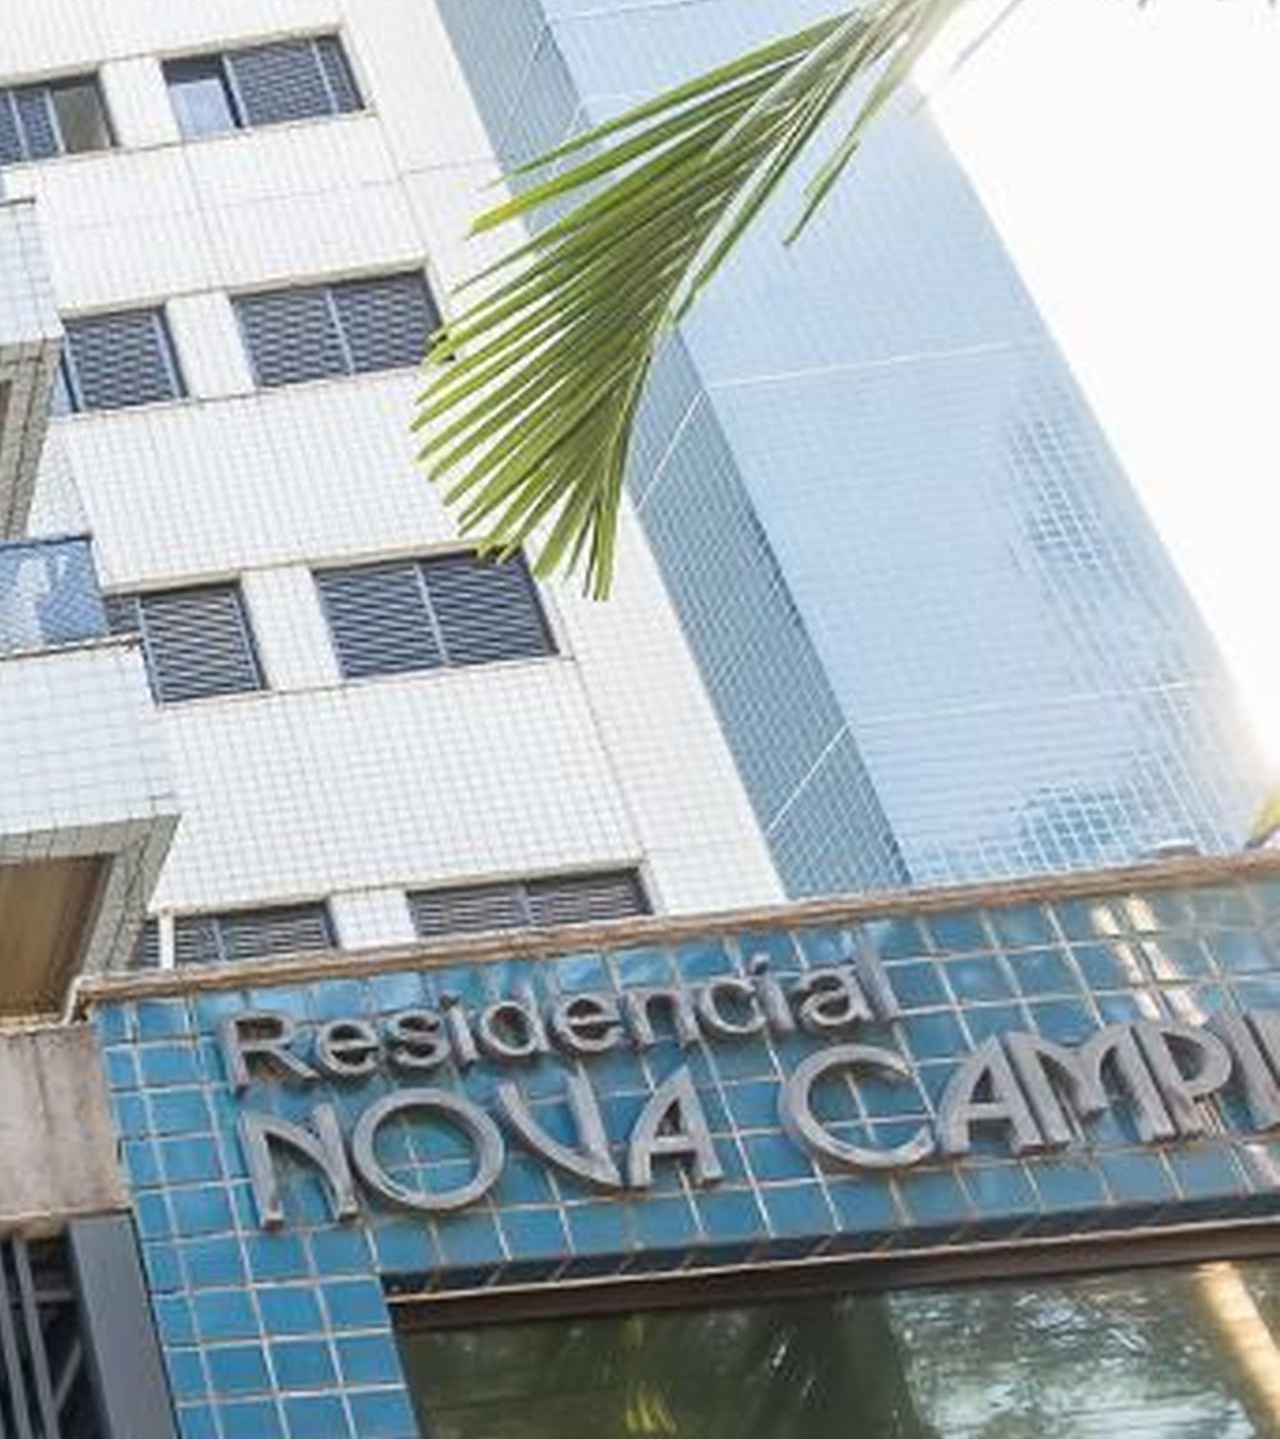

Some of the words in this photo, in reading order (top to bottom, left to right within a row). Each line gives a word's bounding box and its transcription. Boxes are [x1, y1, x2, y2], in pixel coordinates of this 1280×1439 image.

[219, 942, 900, 1093] Residencial
[241, 1066, 726, 1230] NOVA
[781, 1008, 1280, 1168] CAMPI
